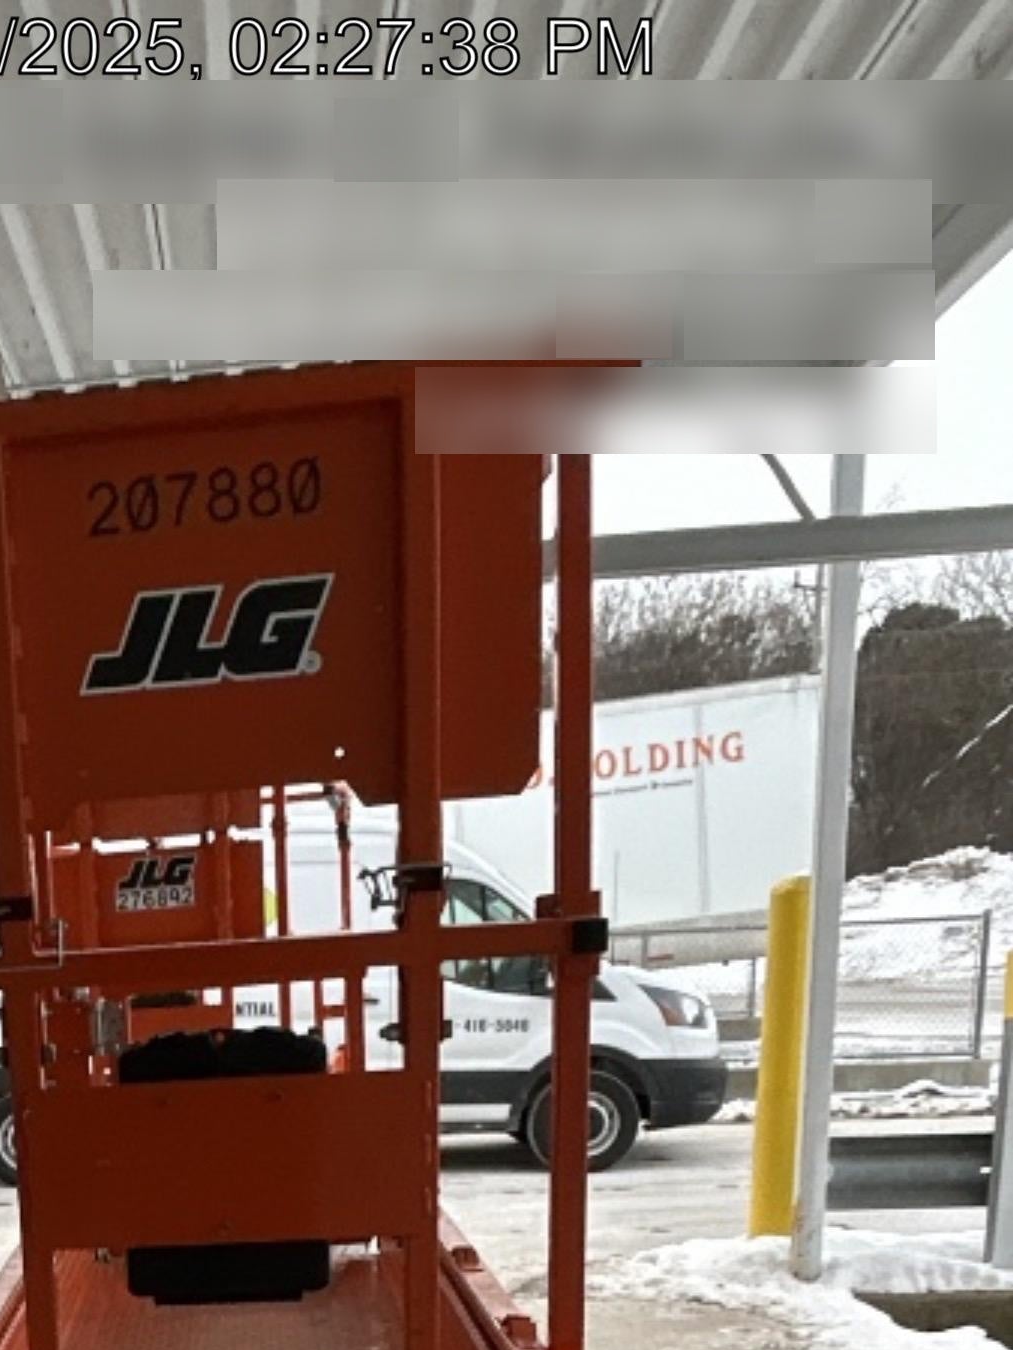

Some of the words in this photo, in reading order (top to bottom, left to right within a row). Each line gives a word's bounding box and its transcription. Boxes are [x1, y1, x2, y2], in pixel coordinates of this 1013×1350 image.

[89, 456, 321, 536] 207880
[80, 573, 335, 696] JLG
[594, 732, 745, 778] OLDING
[118, 857, 194, 889] JLG
[235, 1001, 276, 1018] NTIAL
